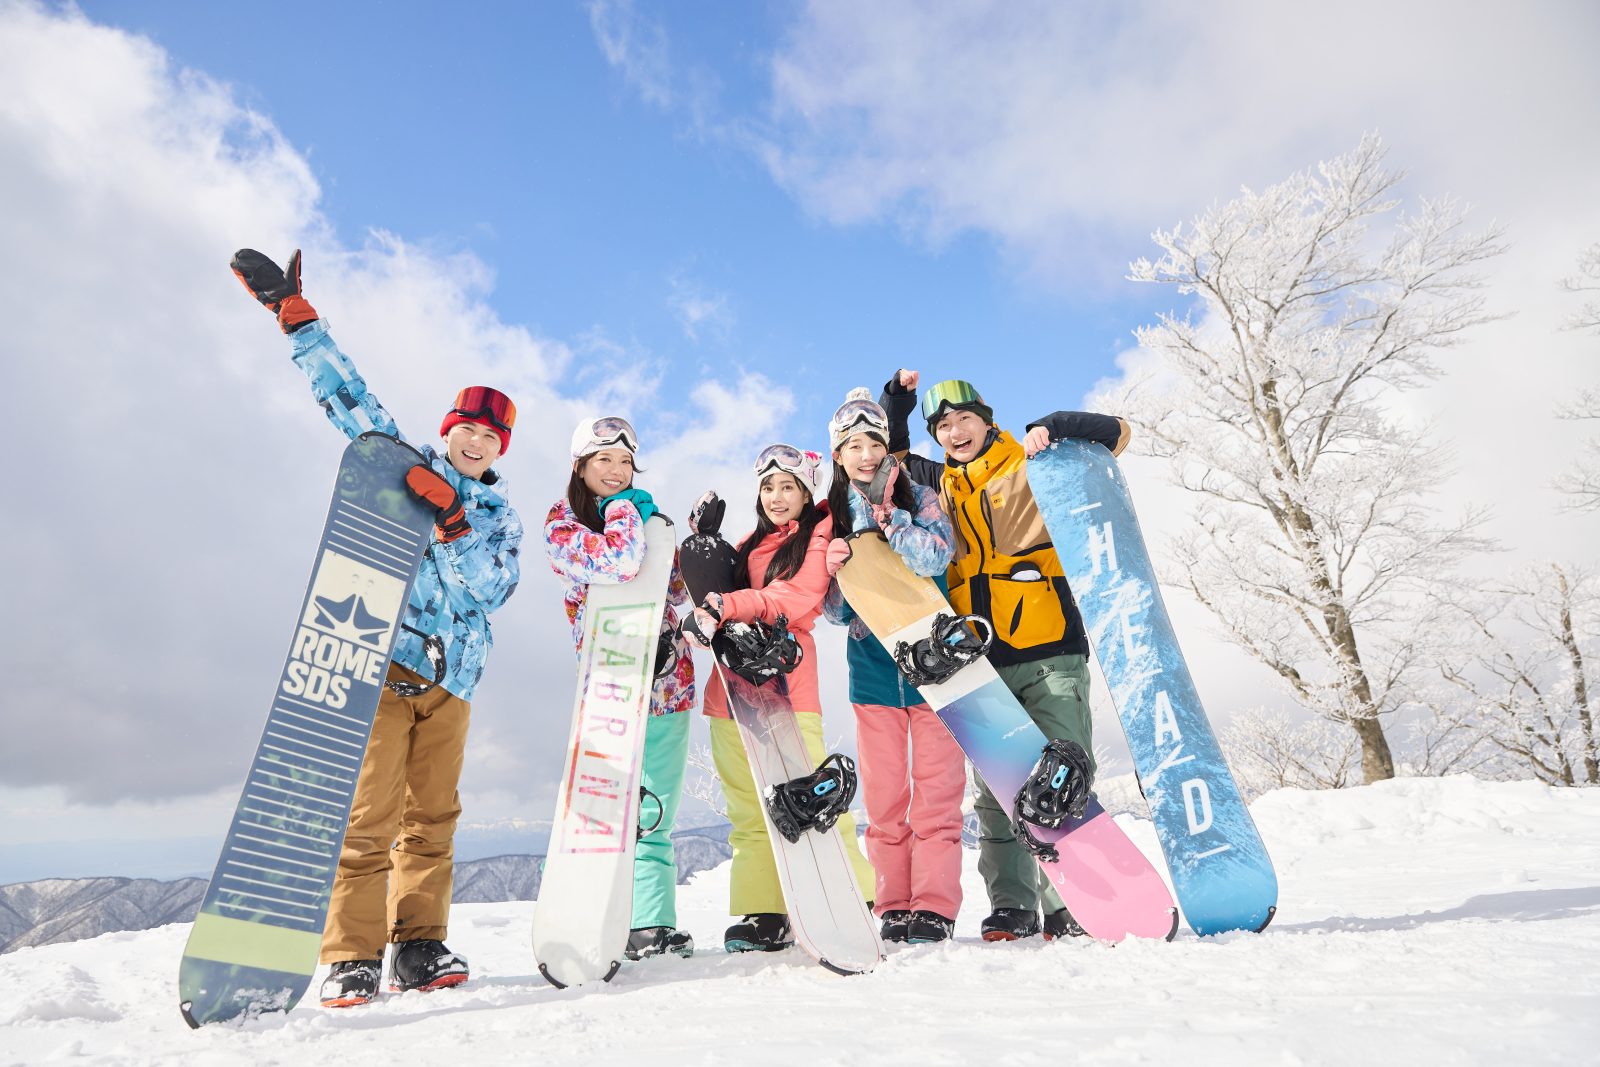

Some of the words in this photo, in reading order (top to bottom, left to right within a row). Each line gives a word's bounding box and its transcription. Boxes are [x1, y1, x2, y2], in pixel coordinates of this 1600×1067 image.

[282, 660, 352, 710] SDS
[291, 626, 387, 687] ROME
[574, 617, 641, 836] SABRINA
[1087, 521, 1214, 837] HEAD
